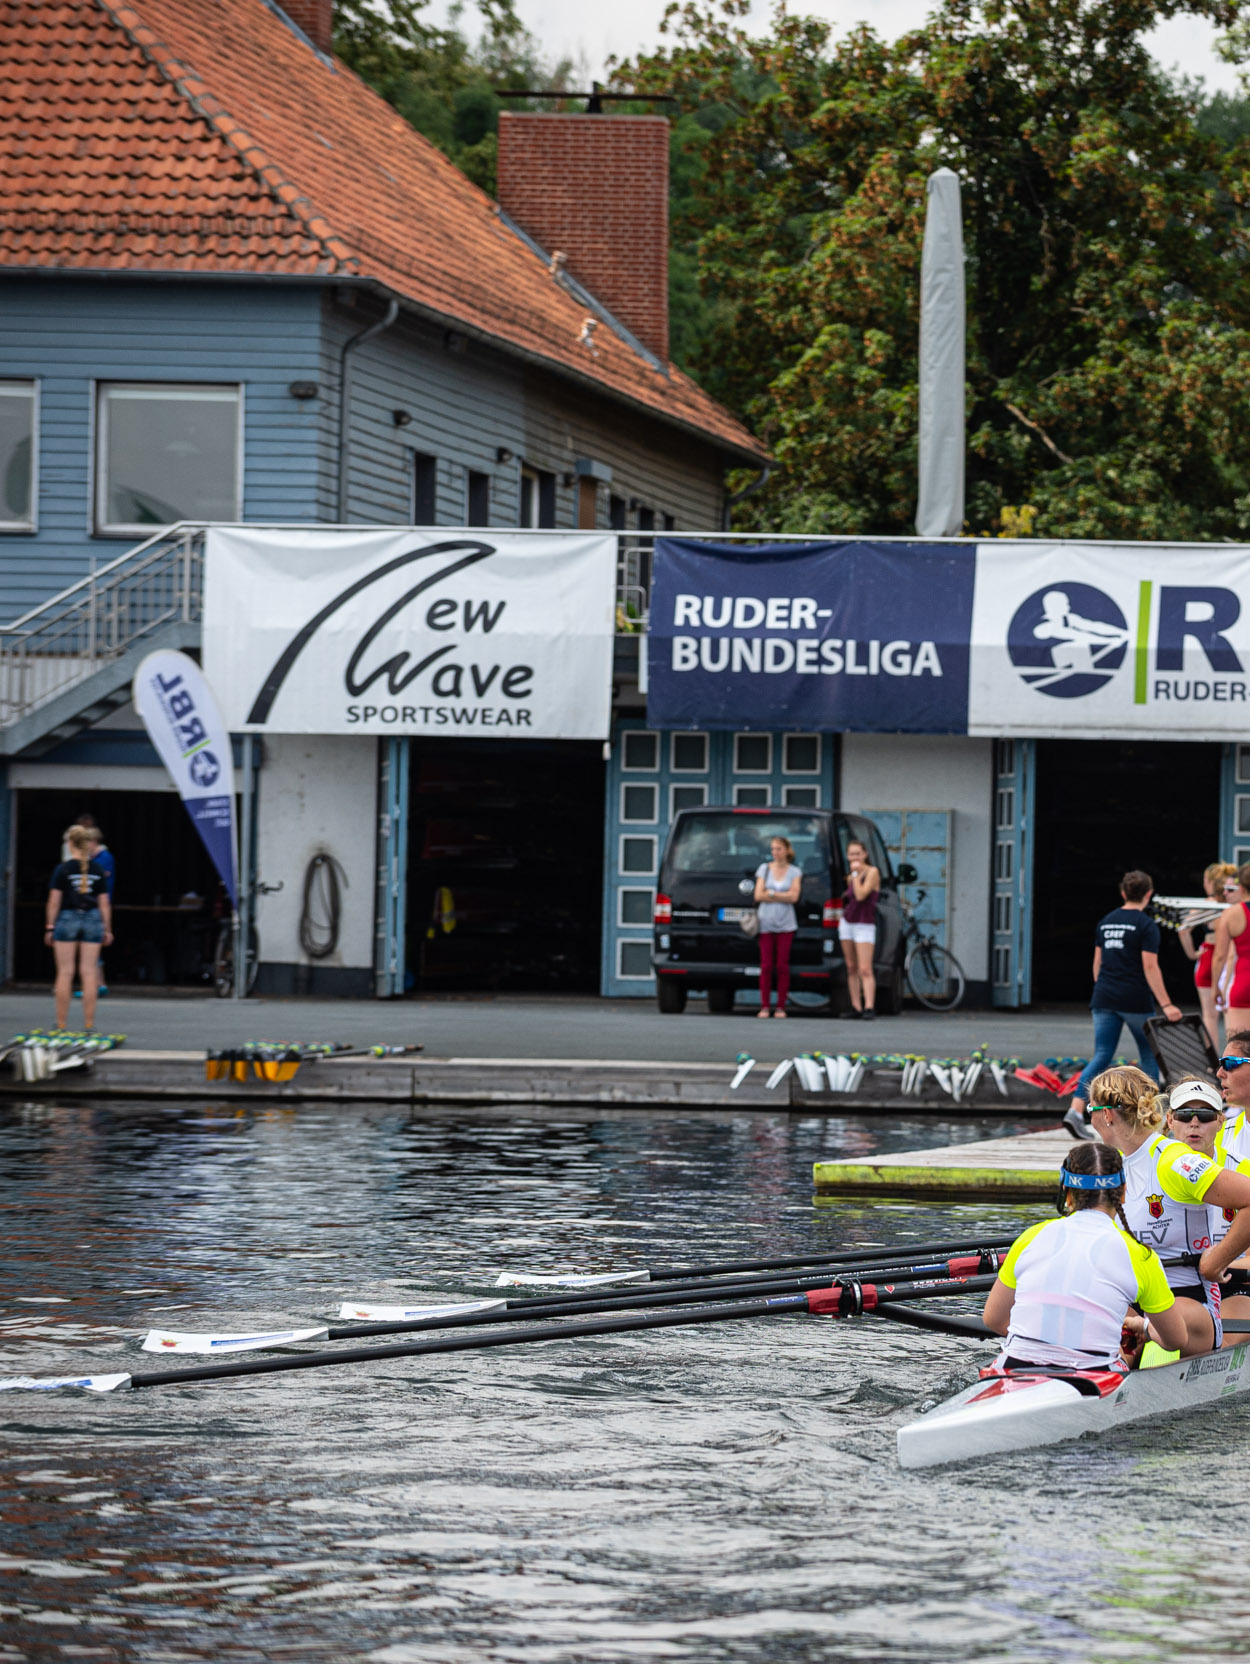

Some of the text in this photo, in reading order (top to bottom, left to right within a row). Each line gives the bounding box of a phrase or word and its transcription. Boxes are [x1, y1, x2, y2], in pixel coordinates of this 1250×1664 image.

[673, 594, 833, 630] RUDER-
[672, 636, 943, 677] BUNDESLIGA
[346, 705, 533, 727] SPORTSWEAR
[1194, 1160, 1210, 1175] RBL
[1068, 1176, 1116, 1187] NK NK
